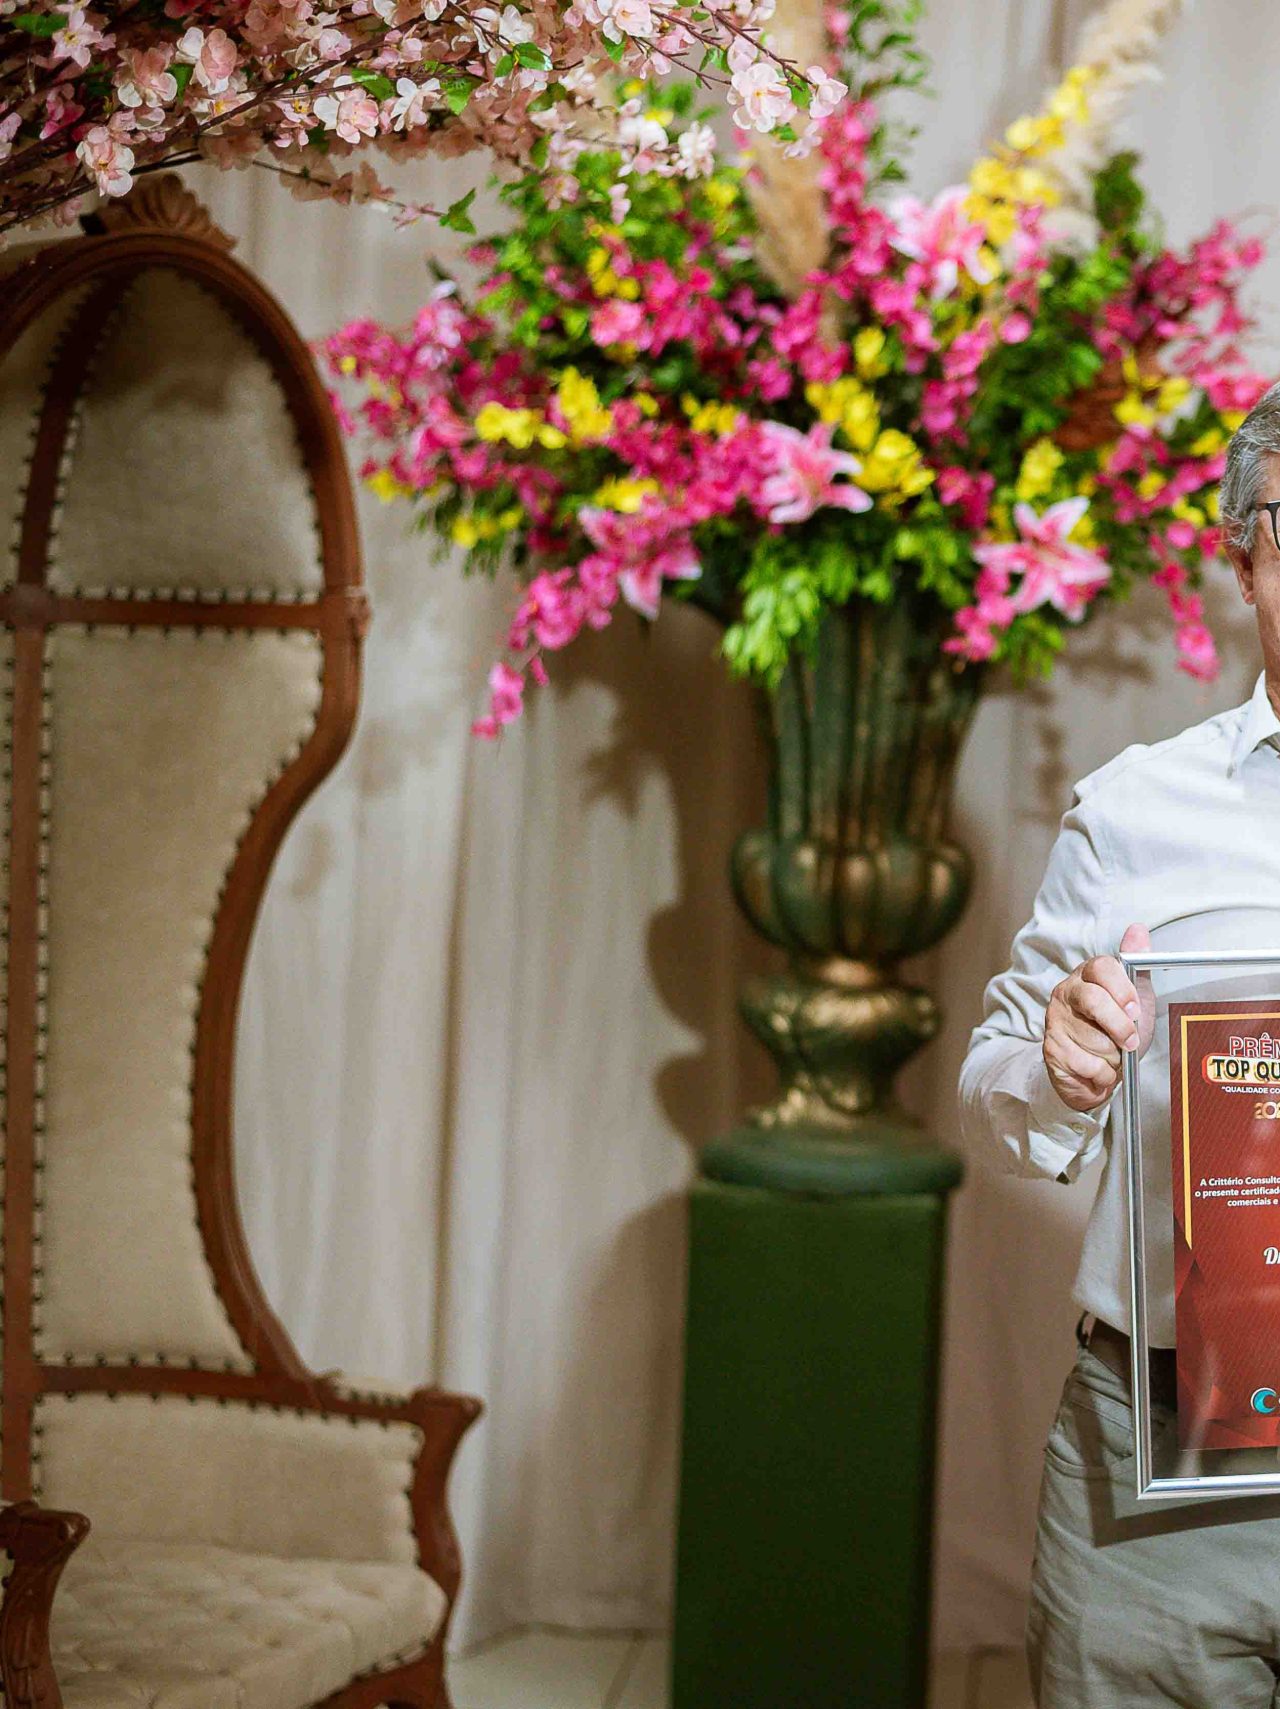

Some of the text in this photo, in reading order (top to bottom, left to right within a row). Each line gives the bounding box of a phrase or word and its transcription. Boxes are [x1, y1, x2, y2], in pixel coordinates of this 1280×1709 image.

[1209, 1058, 1250, 1080] TOP
[1200, 1178, 1207, 1186] A
[1208, 1176, 1243, 1186] Crittério
[1202, 1189, 1239, 1199] presente
[1227, 1197, 1271, 1207] comerciais
